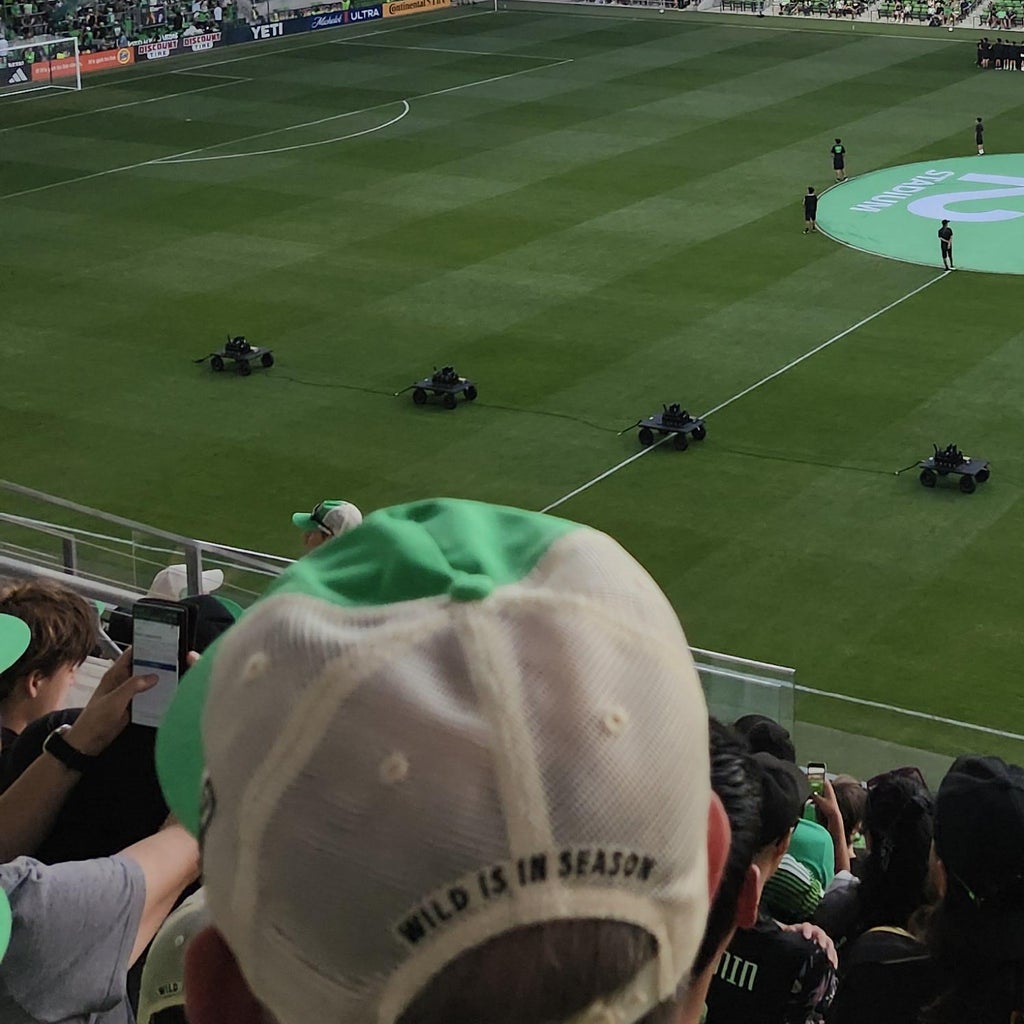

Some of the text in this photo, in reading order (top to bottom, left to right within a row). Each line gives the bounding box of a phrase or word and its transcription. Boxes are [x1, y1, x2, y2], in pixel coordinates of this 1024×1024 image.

[350, 8, 379, 20] ULTRA
[251, 22, 283, 40] YETI
[184, 32, 221, 46] DISCOUNT
[139, 41, 177, 54] DISCOUNT
[150, 50, 166, 58] TIRE
[849, 169, 955, 213] STADIUM
[398, 847, 657, 945] WILD IS IN SEASON
